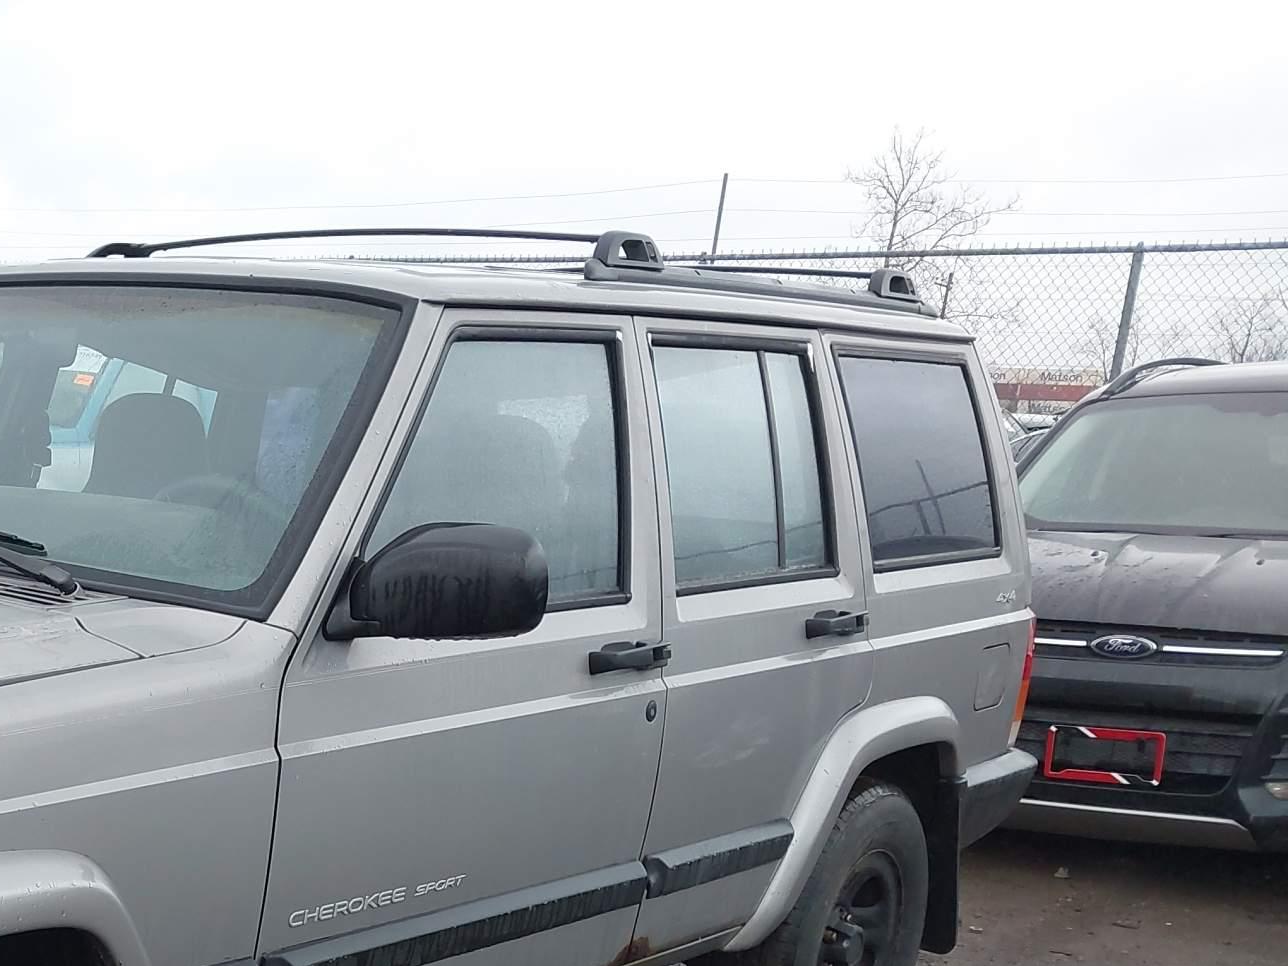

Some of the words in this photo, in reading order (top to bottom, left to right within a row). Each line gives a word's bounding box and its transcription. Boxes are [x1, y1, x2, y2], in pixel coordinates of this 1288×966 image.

[1104, 638, 1142, 652] Ford
[288, 886, 407, 928] CHEROKEE
[414, 873, 466, 897] SPORT
